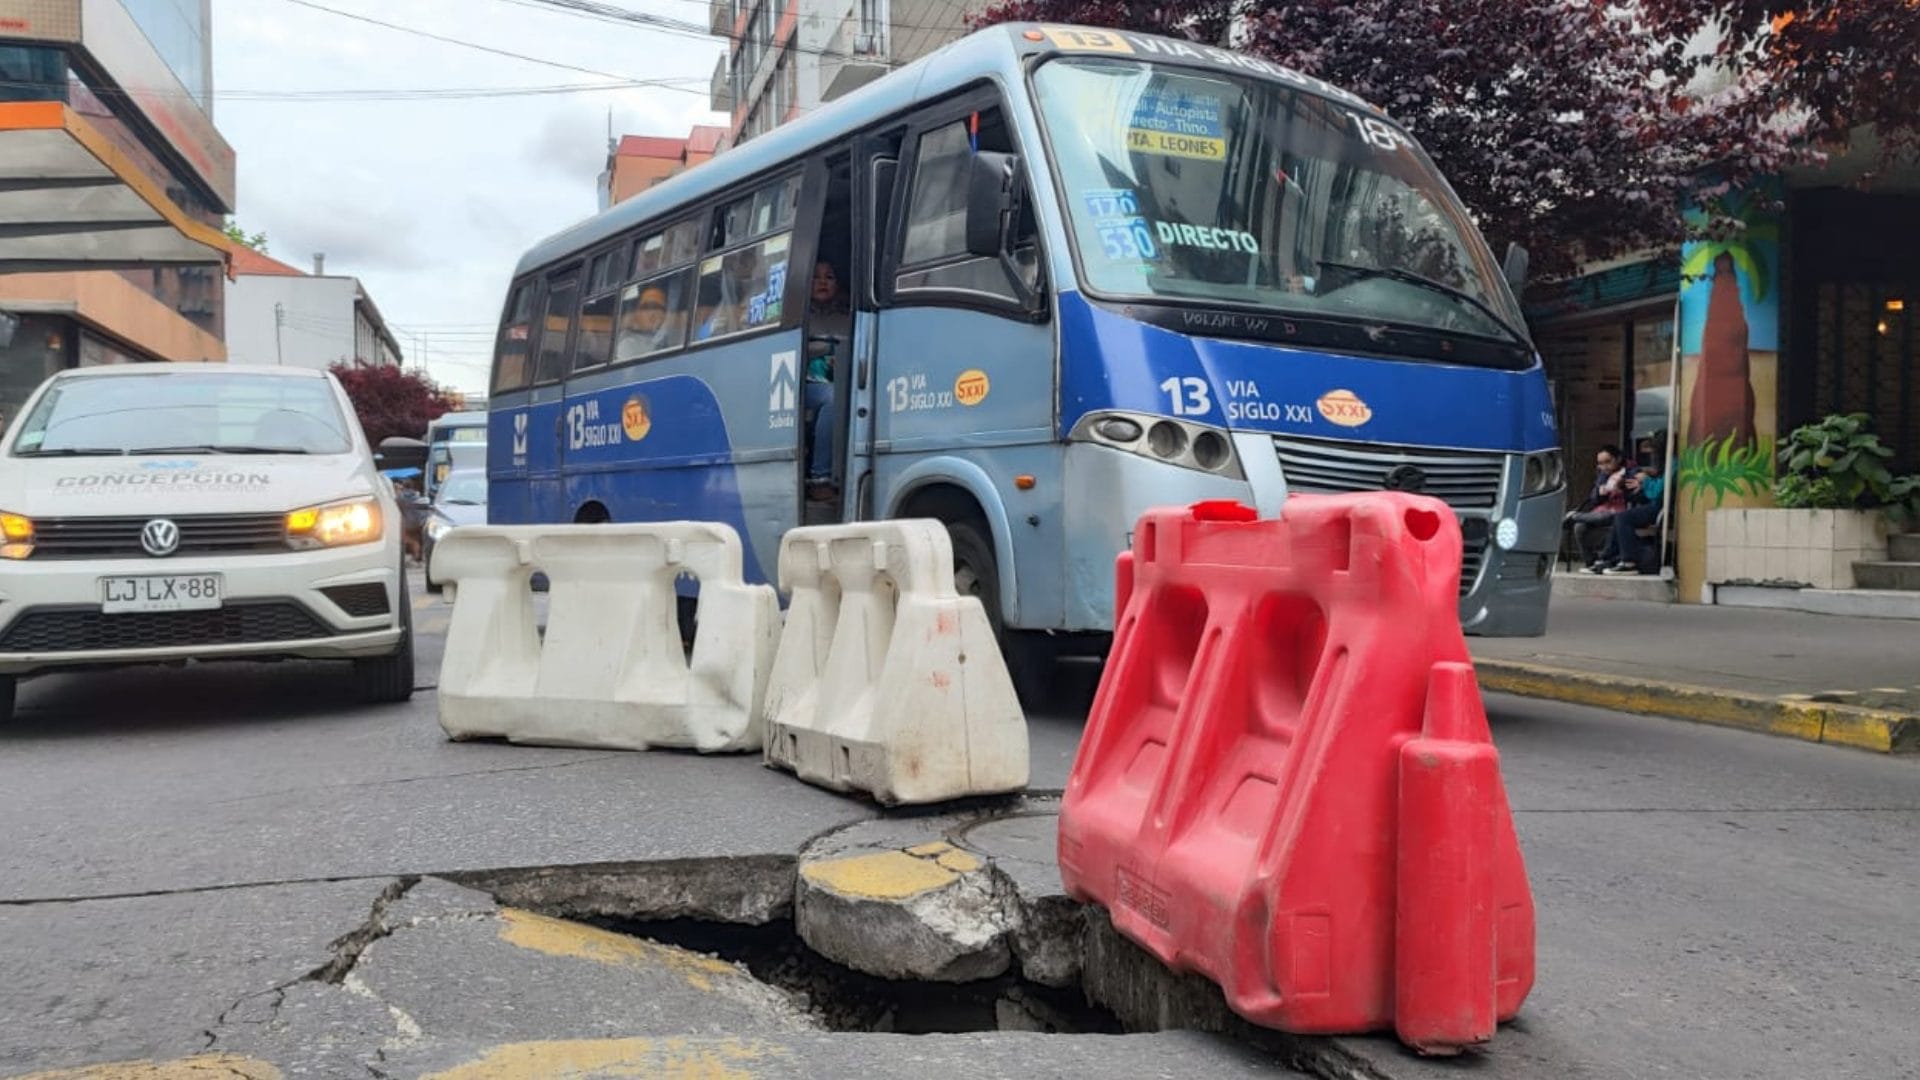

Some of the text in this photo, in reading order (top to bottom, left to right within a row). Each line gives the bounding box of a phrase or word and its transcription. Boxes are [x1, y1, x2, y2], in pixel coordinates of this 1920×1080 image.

[1057, 31, 1307, 84] 13 VIA SIGLO
[1156, 100, 1218, 121] Autopista
[1159, 135, 1218, 157] LEONES
[1100, 225, 1156, 259] 530
[1156, 221, 1259, 254] DIRECTO
[911, 374, 926, 391] VIA
[958, 383, 985, 399] SXXI
[1226, 380, 1260, 398] VIA
[887, 376, 908, 413] 13
[910, 391, 953, 411] SIGLO XXI
[1160, 376, 1211, 416] 13
[585, 399, 599, 420] VIA
[1229, 401, 1313, 424] SIGLO XXI
[1321, 400, 1366, 418] SXXI
[567, 404, 585, 450] 13
[584, 423, 622, 447] SIGLO XXI
[56, 473, 270, 488] CONCEPCION
